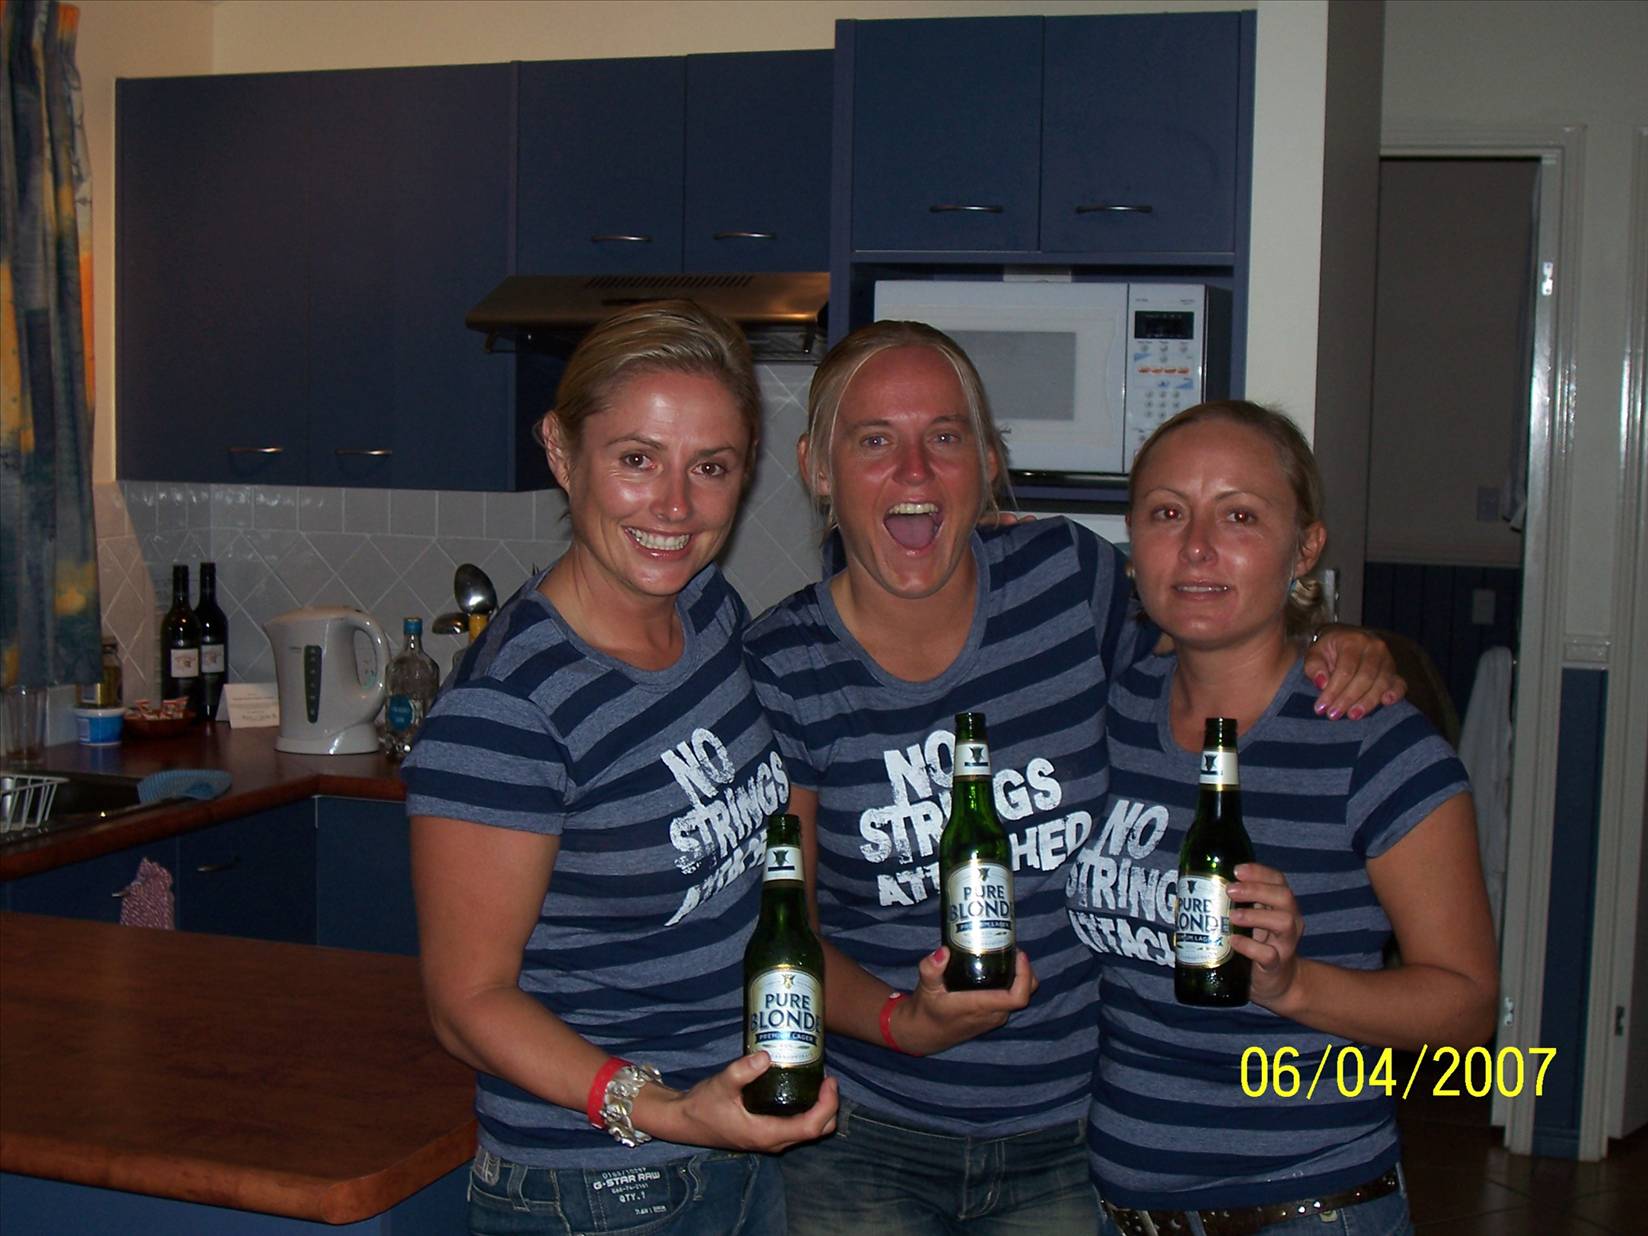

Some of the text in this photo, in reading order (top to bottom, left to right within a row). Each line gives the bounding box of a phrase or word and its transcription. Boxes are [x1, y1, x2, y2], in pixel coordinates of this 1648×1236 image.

[660, 728, 736, 805] NO
[884, 730, 956, 804] NO
[669, 751, 791, 874] STRINGS
[859, 757, 1062, 864] STRGS
[1094, 800, 1169, 860] NO
[877, 811, 1093, 907] ATTHED
[1065, 847, 1180, 925] STRING
[765, 993, 811, 1012] PURE
[638, 1171, 661, 1182] RAW
